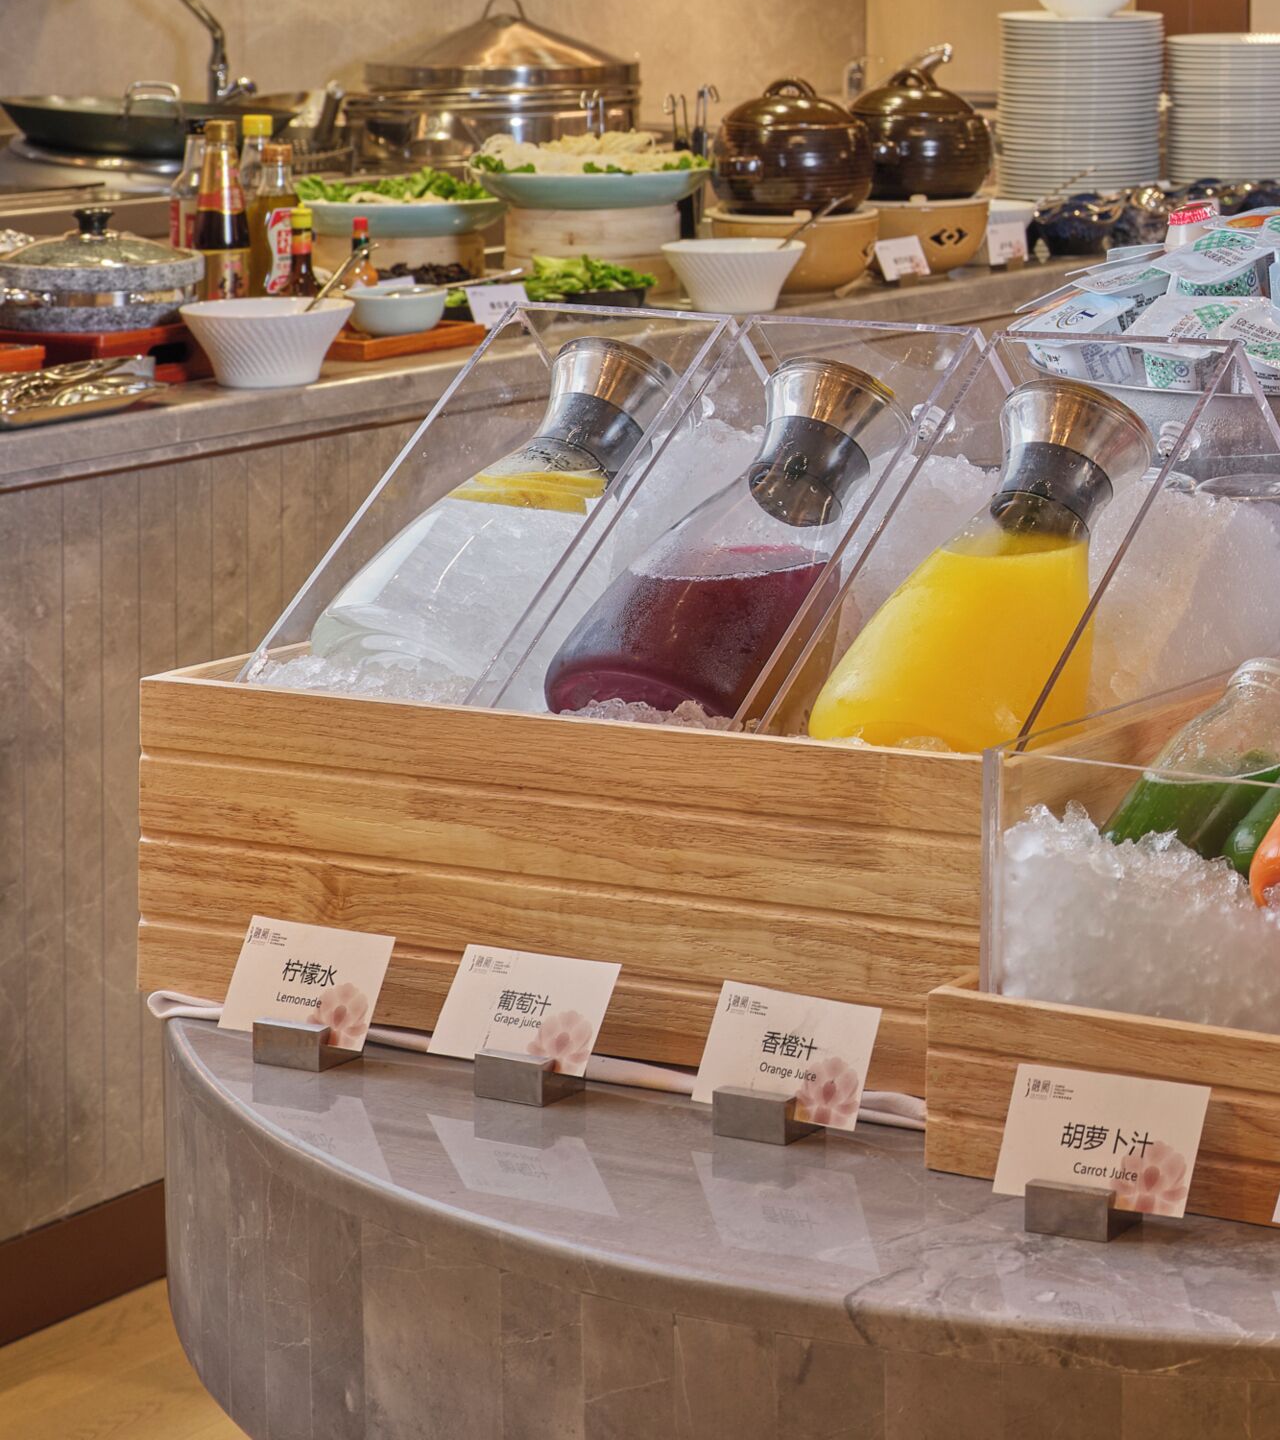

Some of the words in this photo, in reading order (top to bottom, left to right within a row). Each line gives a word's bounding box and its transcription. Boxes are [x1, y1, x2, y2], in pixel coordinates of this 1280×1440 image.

[282, 959, 338, 987] 柠檬水
[276, 991, 322, 1009] Lemonade
[497, 989, 552, 1017] 葡萄汁
[493, 1012, 520, 1026] Grape
[762, 1031, 818, 1061] 香橙汁
[759, 1062, 793, 1079] Orange
[794, 1069, 817, 1082] Juice
[1061, 1122, 1154, 1159] 胡萝卜汁
[1073, 1161, 1108, 1178] Carrot
[1109, 1167, 1138, 1181] Juice
